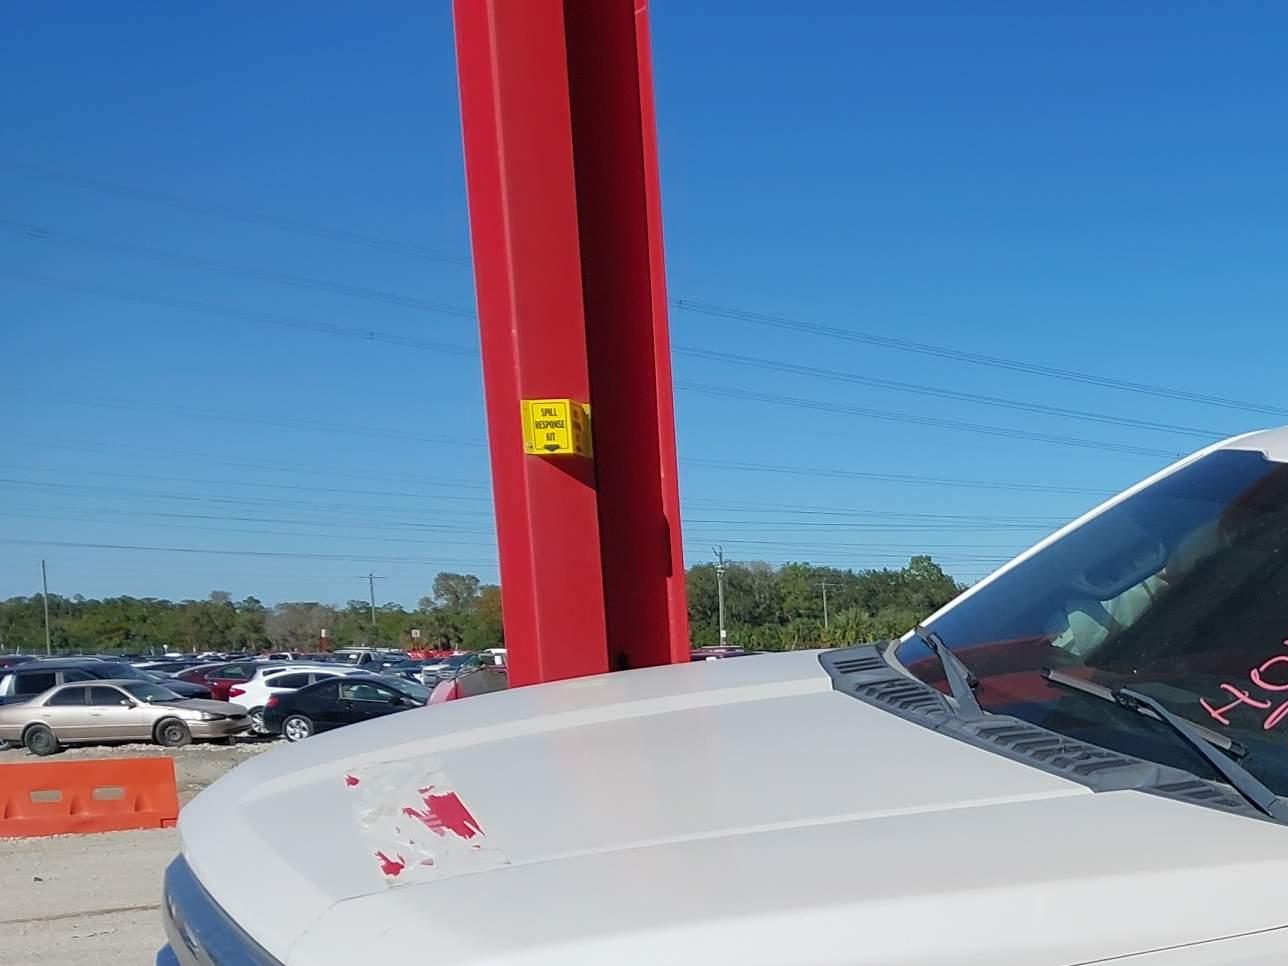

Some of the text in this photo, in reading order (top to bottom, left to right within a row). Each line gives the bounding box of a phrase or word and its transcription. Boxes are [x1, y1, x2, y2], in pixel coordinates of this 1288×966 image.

[540, 407, 558, 417] SPILL
[534, 420, 566, 430] RESPONSE
[545, 432, 556, 441] KIT
